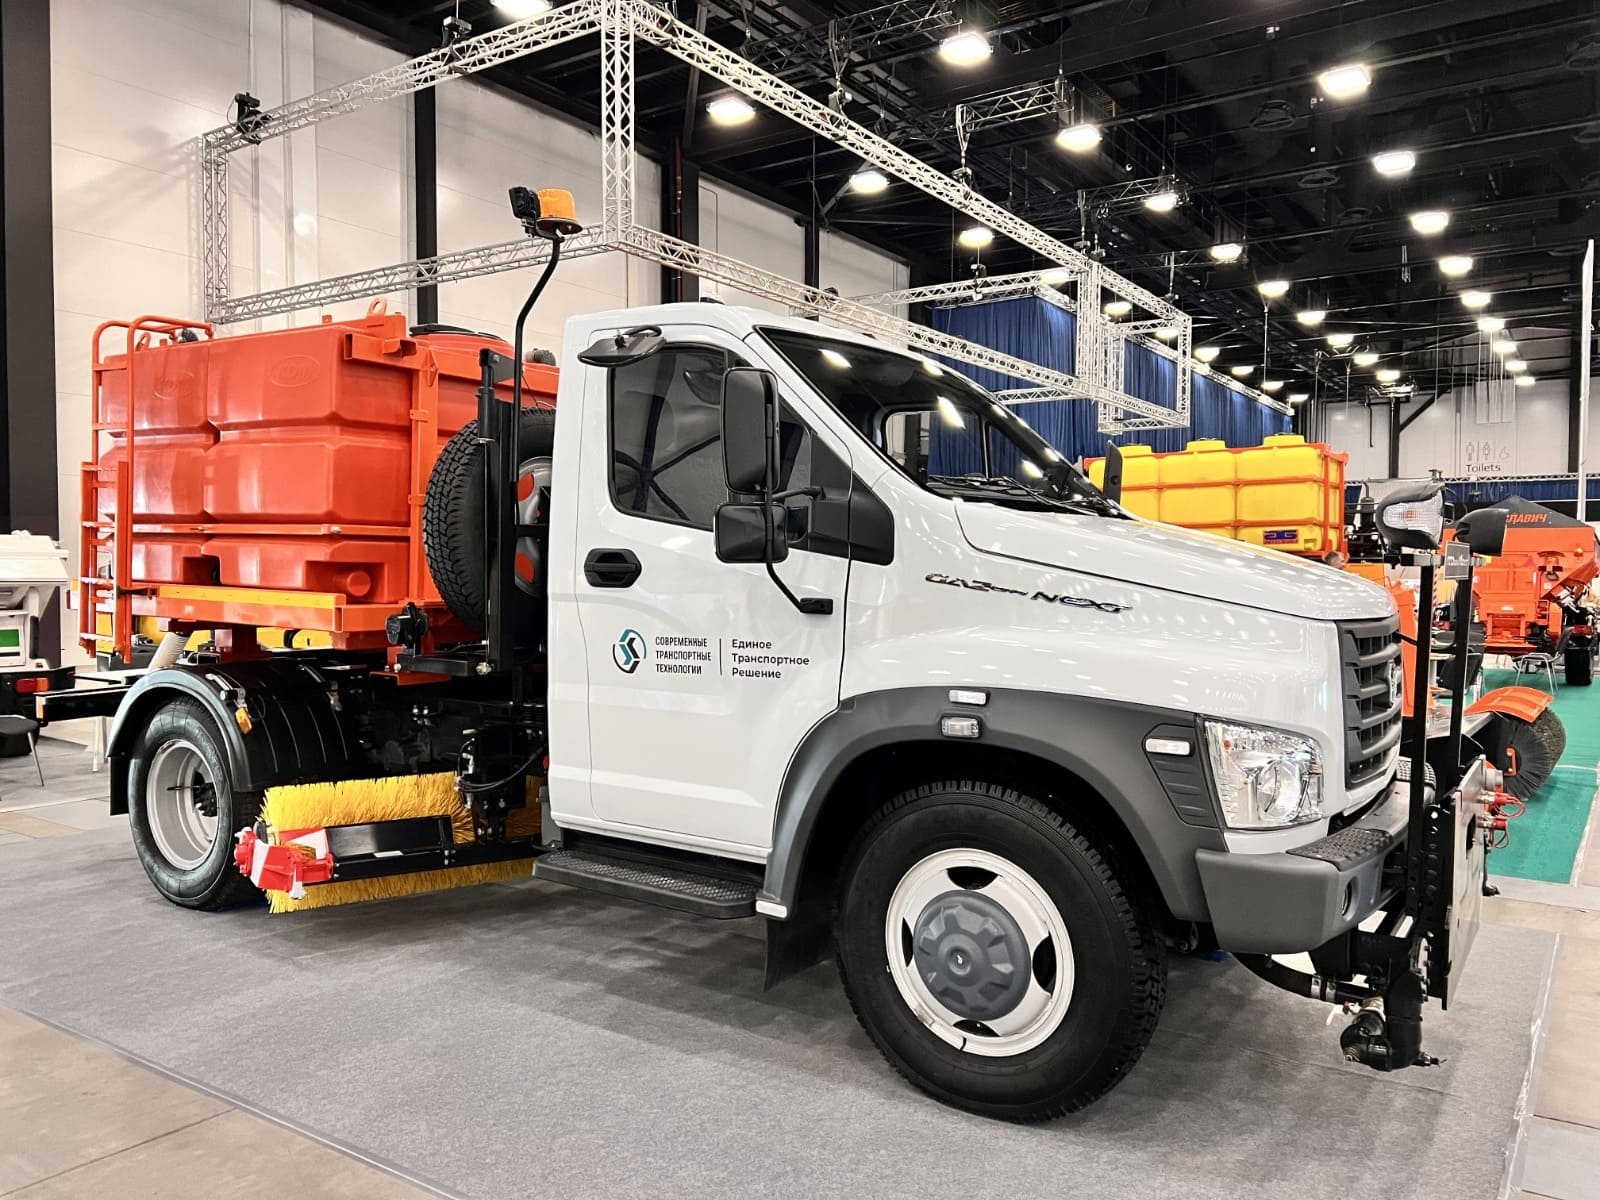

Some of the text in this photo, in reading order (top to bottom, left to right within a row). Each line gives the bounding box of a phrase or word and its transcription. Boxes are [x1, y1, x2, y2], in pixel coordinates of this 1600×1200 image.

[1466, 464, 1501, 473] Toilets
[655, 636, 708, 648] СОВРЕМЕННЫЕ
[731, 638, 773, 650] Единое
[655, 650, 712, 662] ТРАНСПОРТНЫЕ
[731, 652, 811, 667] Транспортное
[655, 663, 702, 675] ТЕХНОЛОГИИ
[731, 667, 782, 679] Решение
